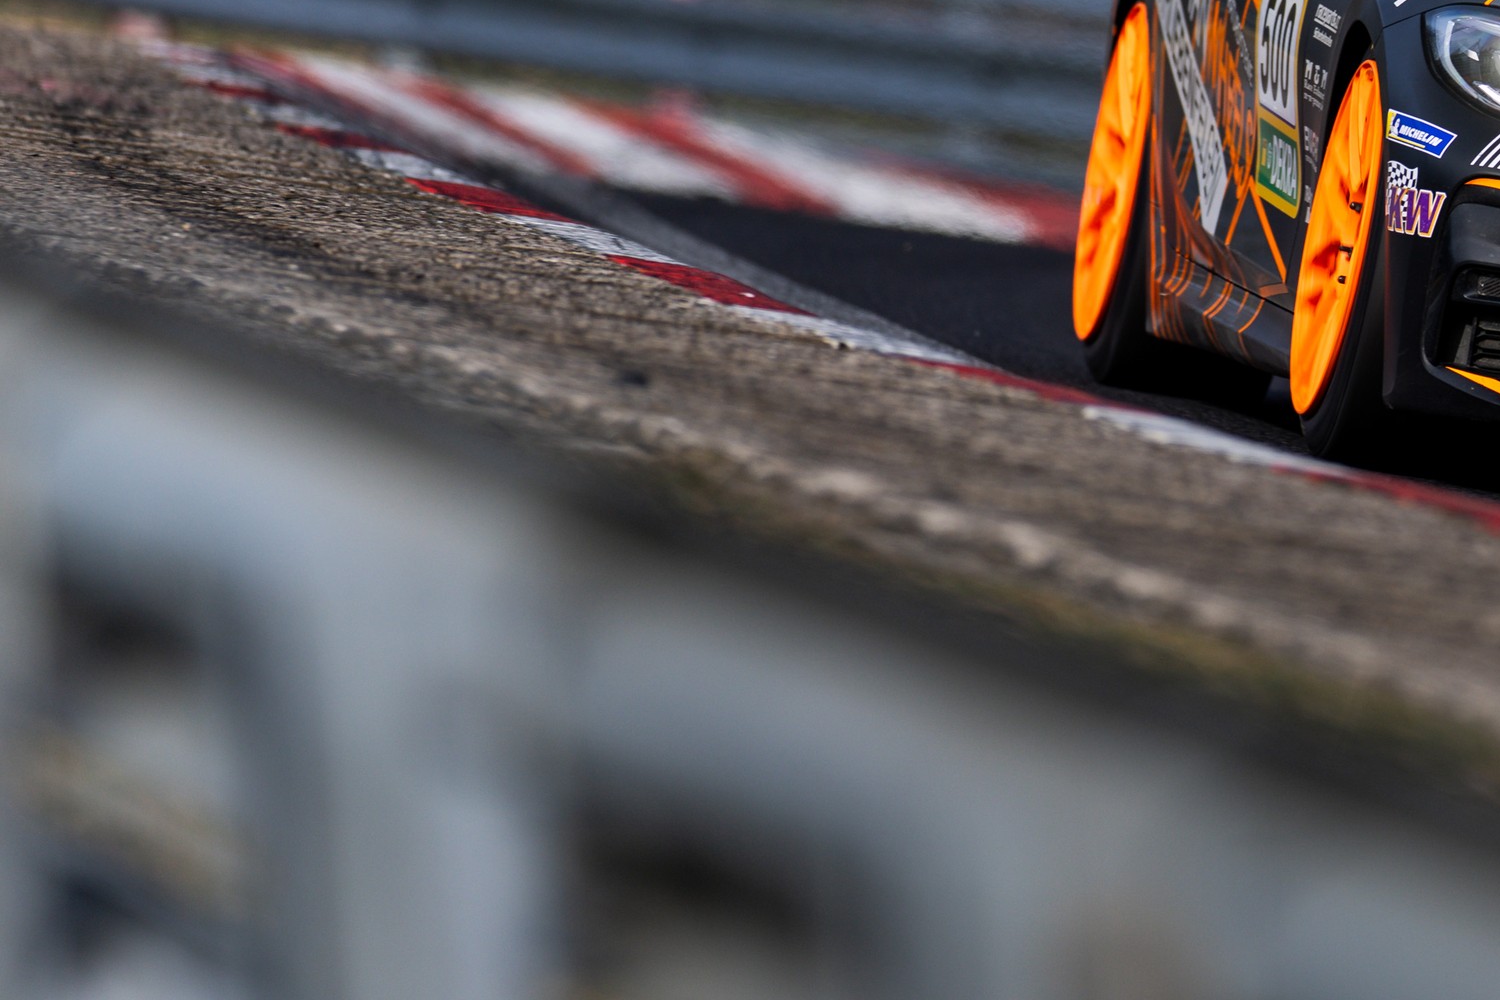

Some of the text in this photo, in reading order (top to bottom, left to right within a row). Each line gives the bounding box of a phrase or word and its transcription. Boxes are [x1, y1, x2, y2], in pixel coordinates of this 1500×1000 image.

[1398, 124, 1443, 147] MICHELIN
[1270, 134, 1298, 200] DEKRA
[1386, 185, 1447, 239] KW
